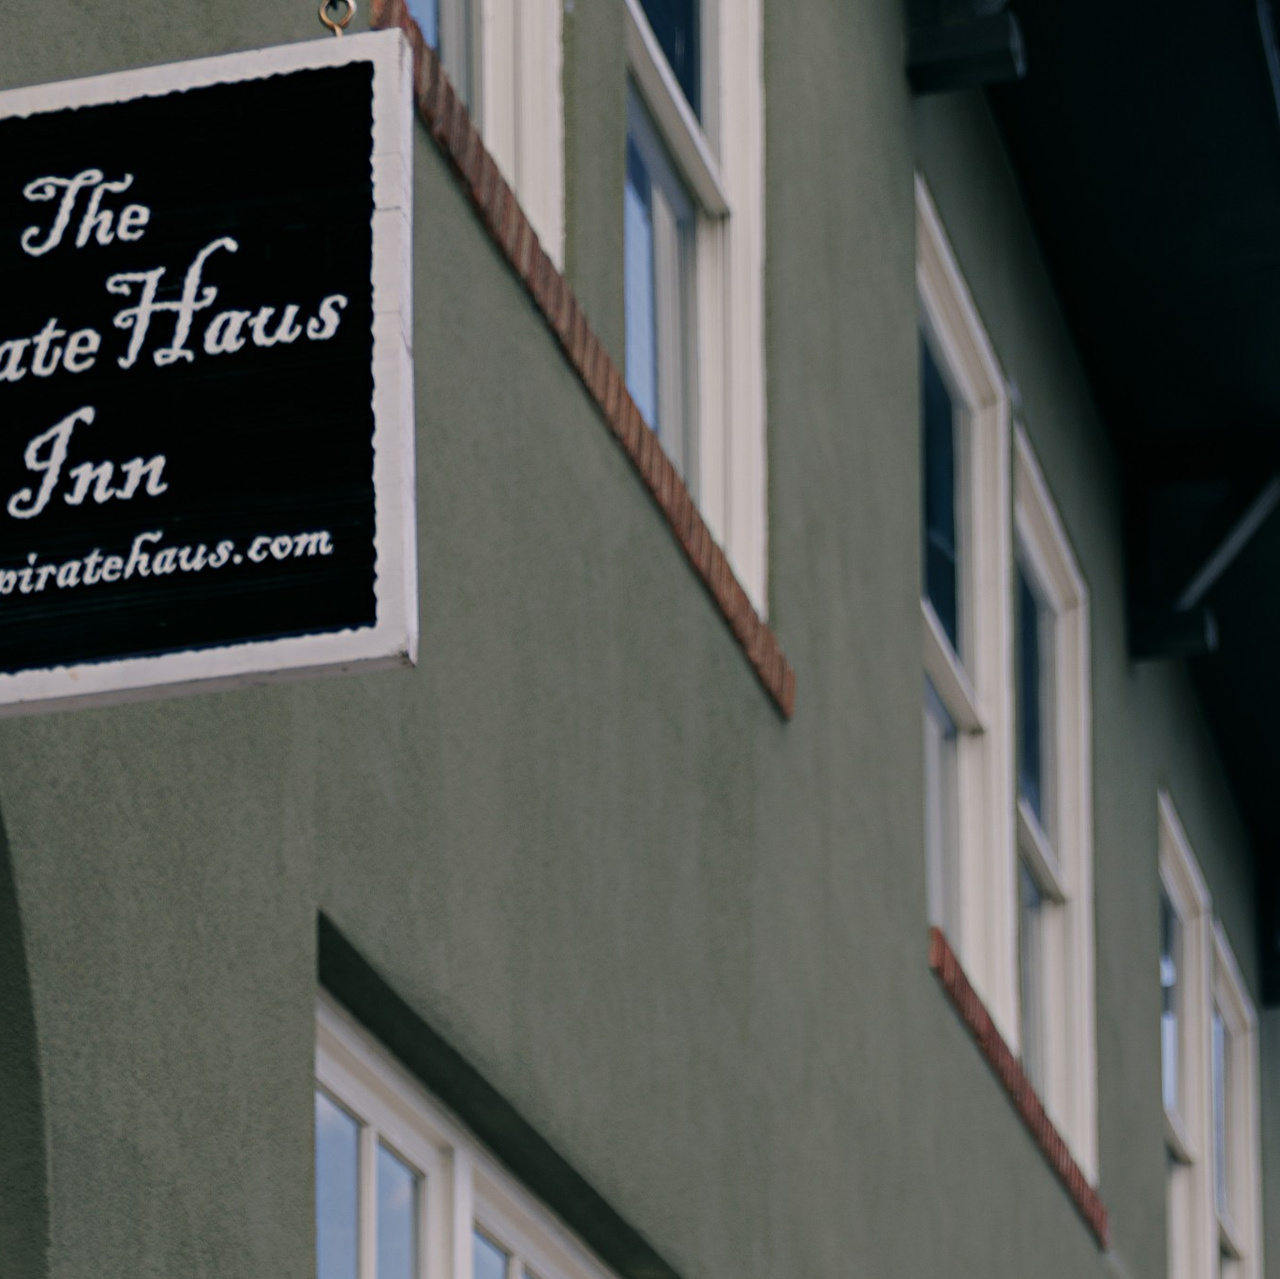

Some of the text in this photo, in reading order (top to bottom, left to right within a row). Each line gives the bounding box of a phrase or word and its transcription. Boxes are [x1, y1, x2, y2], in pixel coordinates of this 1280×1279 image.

[21, 168, 150, 257] The
[106, 236, 348, 369] Haus
[7, 406, 168, 519] Inn
